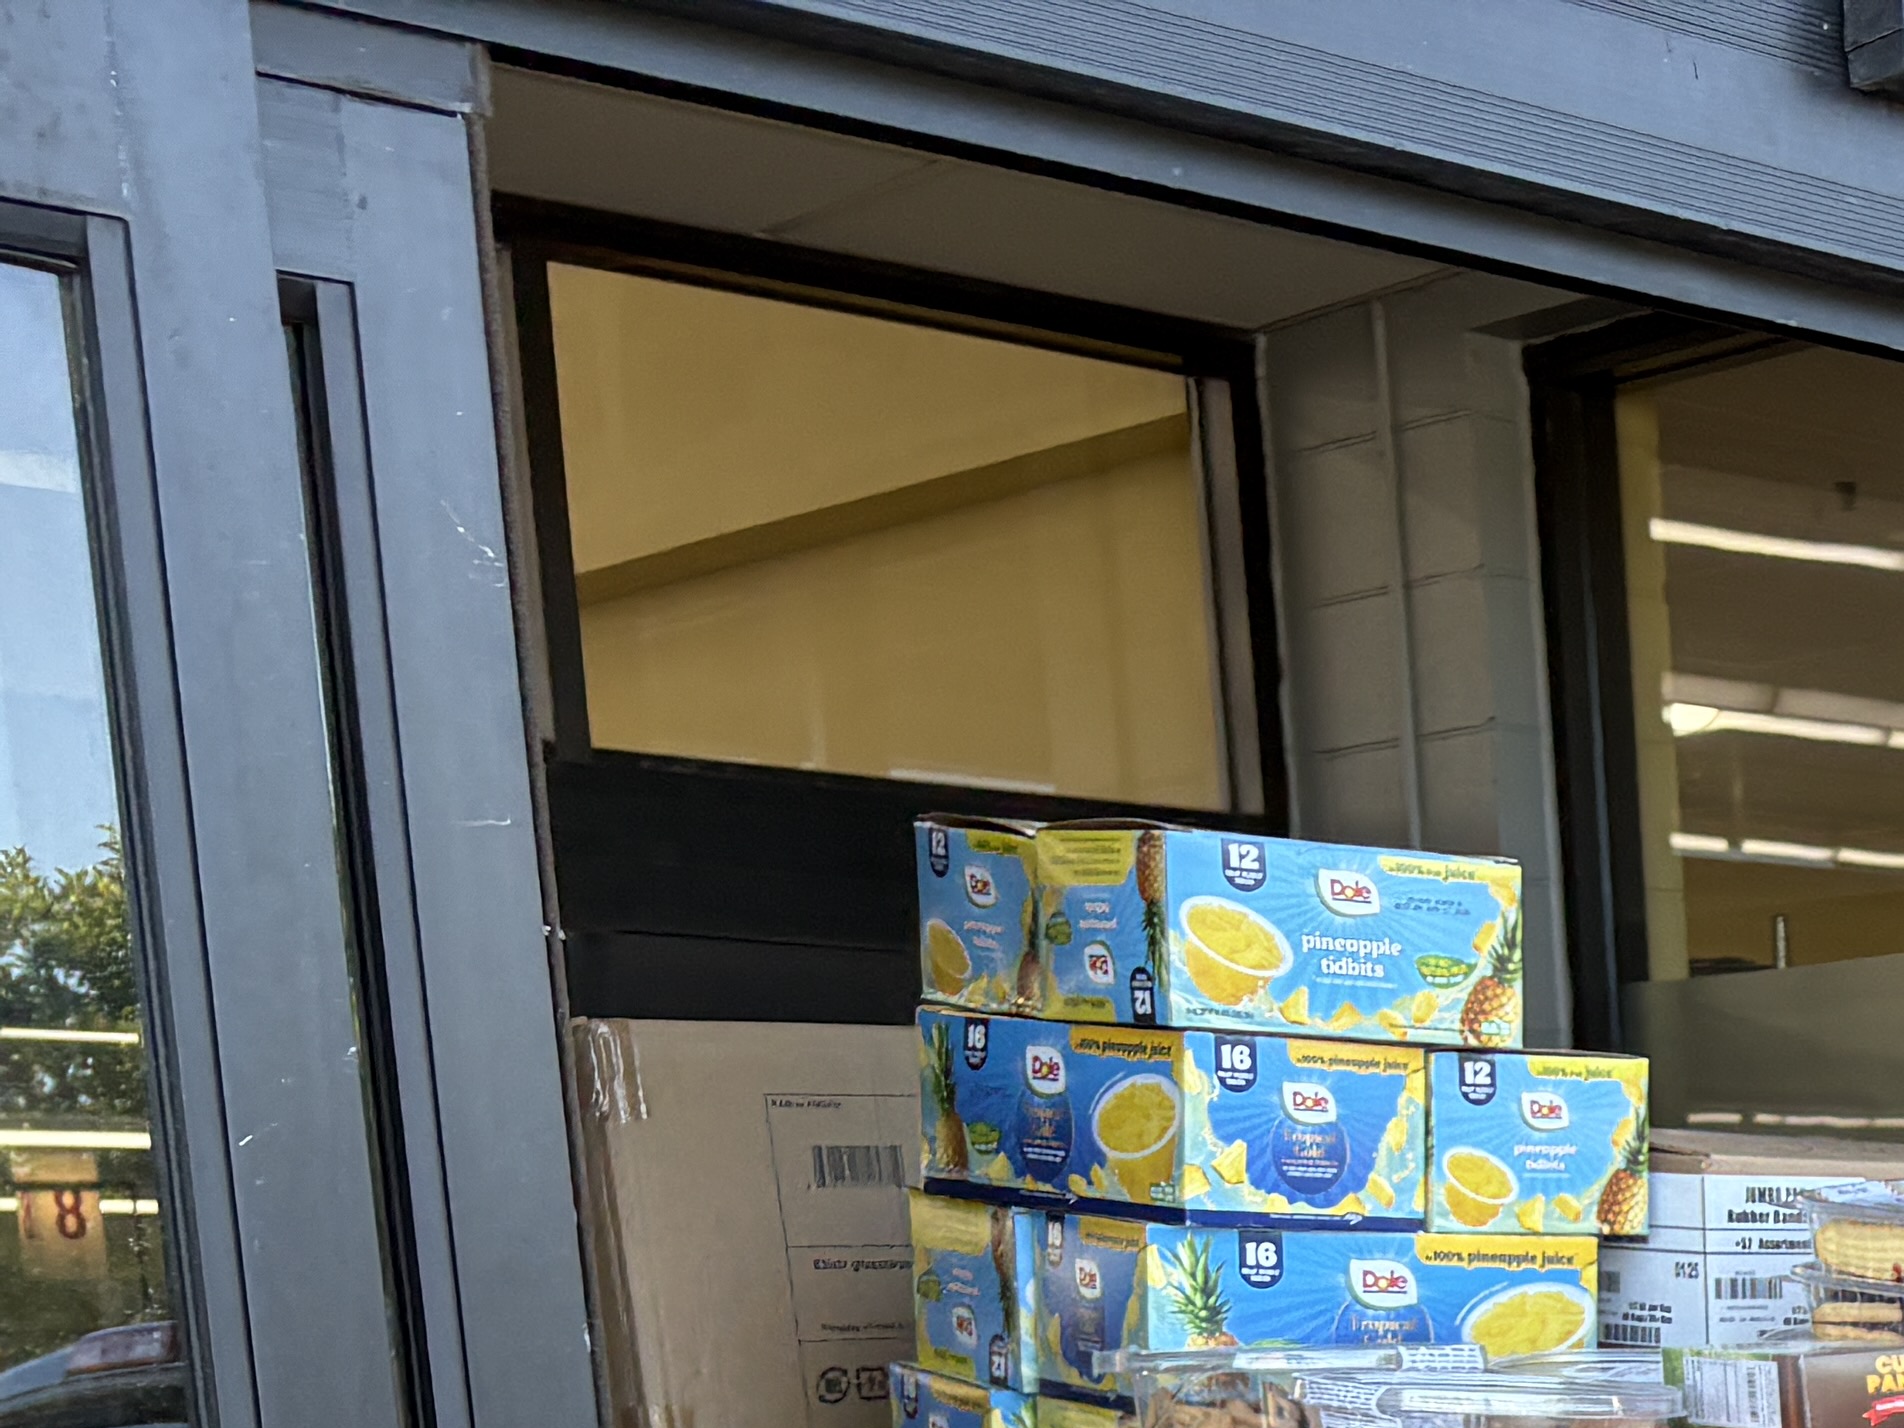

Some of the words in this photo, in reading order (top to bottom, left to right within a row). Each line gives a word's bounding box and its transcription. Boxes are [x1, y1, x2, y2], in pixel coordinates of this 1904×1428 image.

[1228, 842, 1260, 869] 12
[1330, 878, 1374, 904] Dole
[1301, 932, 1402, 958] pineapple
[1320, 958, 1385, 979] tidbits
[1031, 1055, 1061, 1080] Dole
[1221, 1044, 1253, 1071] 16
[1464, 1061, 1492, 1084] 12
[1292, 1091, 1330, 1110] Dole
[1530, 1100, 1563, 1119] Dole
[1245, 1241, 1279, 1265] 16
[1467, 1251, 1538, 1267] pineapple
[1540, 1253, 1577, 1267] juice
[1362, 1268, 1409, 1294] Dole
